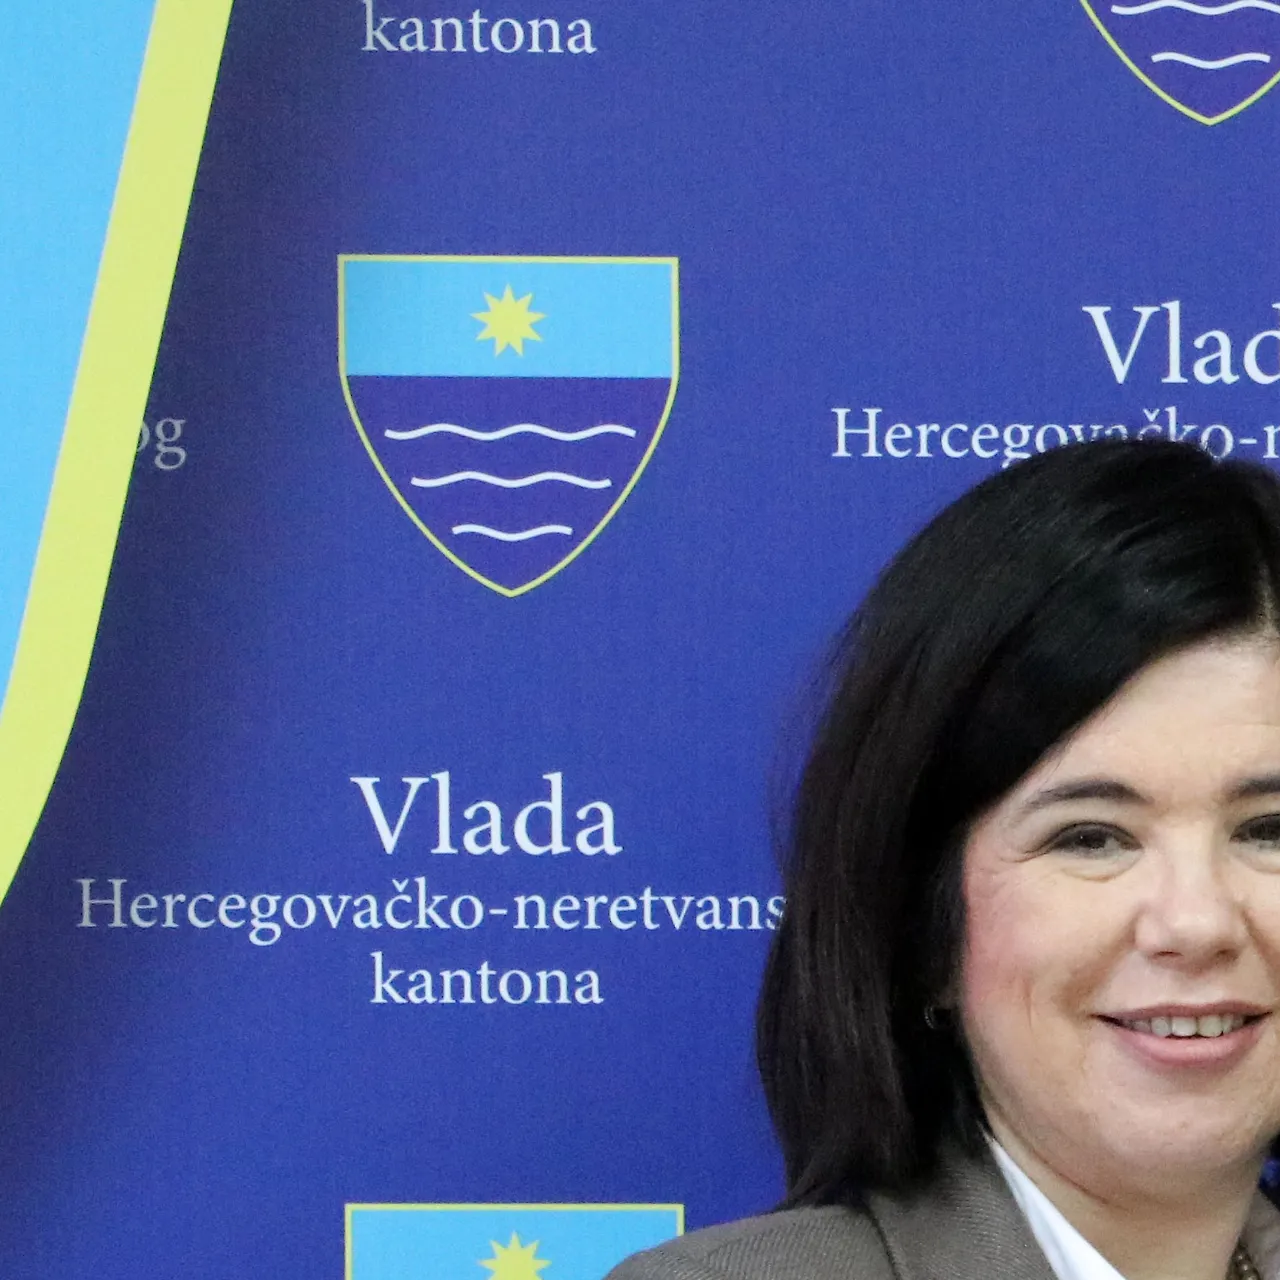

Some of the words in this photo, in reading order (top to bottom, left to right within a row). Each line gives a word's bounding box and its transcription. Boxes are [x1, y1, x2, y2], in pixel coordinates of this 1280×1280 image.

[361, 0, 598, 54] kantona
[349, 770, 623, 856] Vlada
[75, 877, 786, 946] Hercegovačko-neretvans
[370, 950, 604, 1005] kantona
